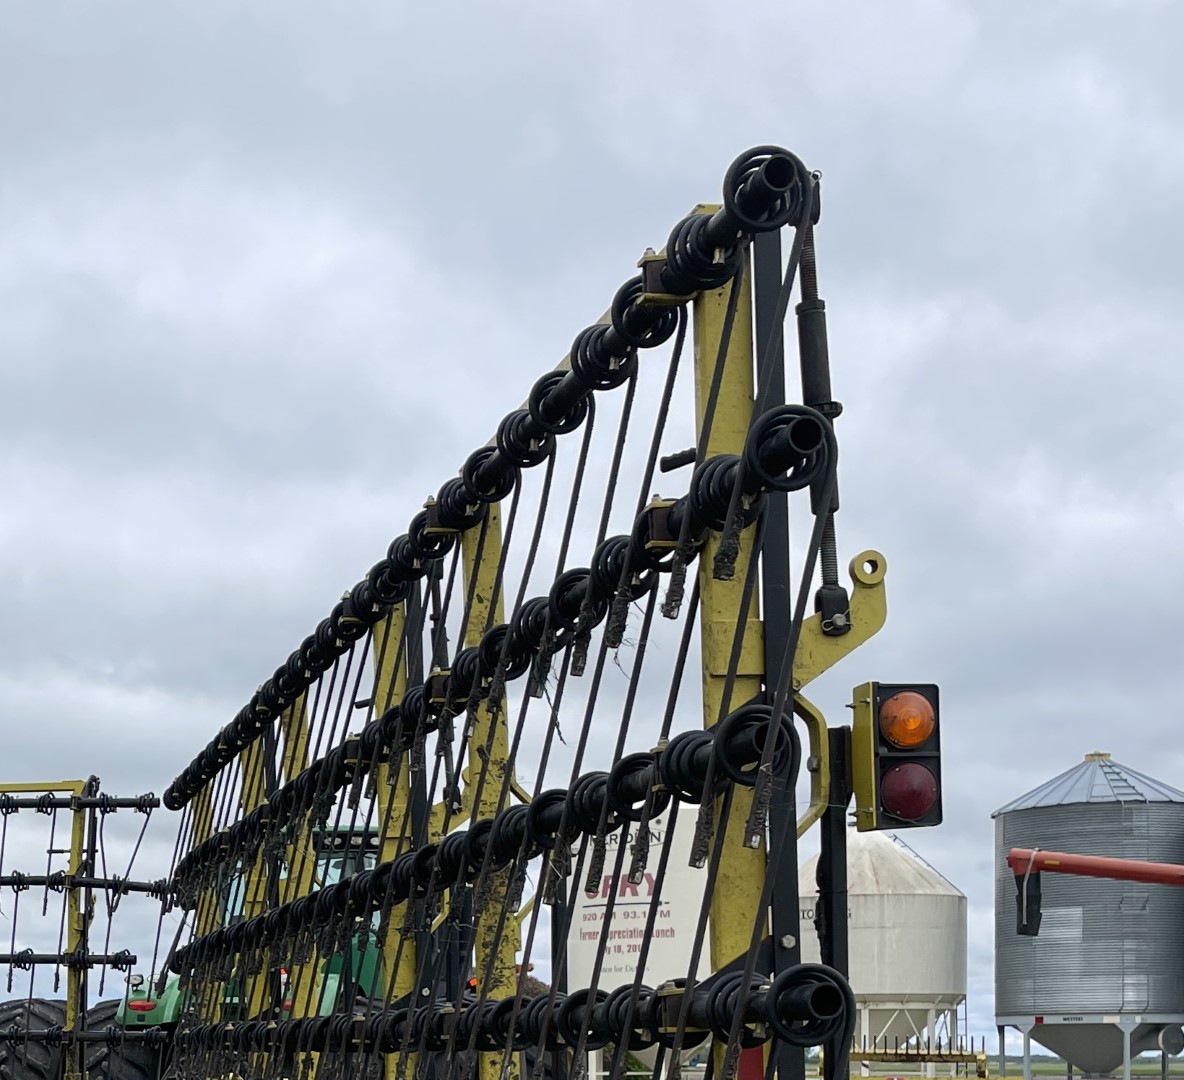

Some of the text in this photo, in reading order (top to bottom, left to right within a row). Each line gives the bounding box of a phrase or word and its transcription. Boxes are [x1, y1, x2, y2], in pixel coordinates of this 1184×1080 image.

[583, 912, 597, 921] 920
[623, 910, 647, 920] 93.1
[607, 927, 645, 941] preciatio
